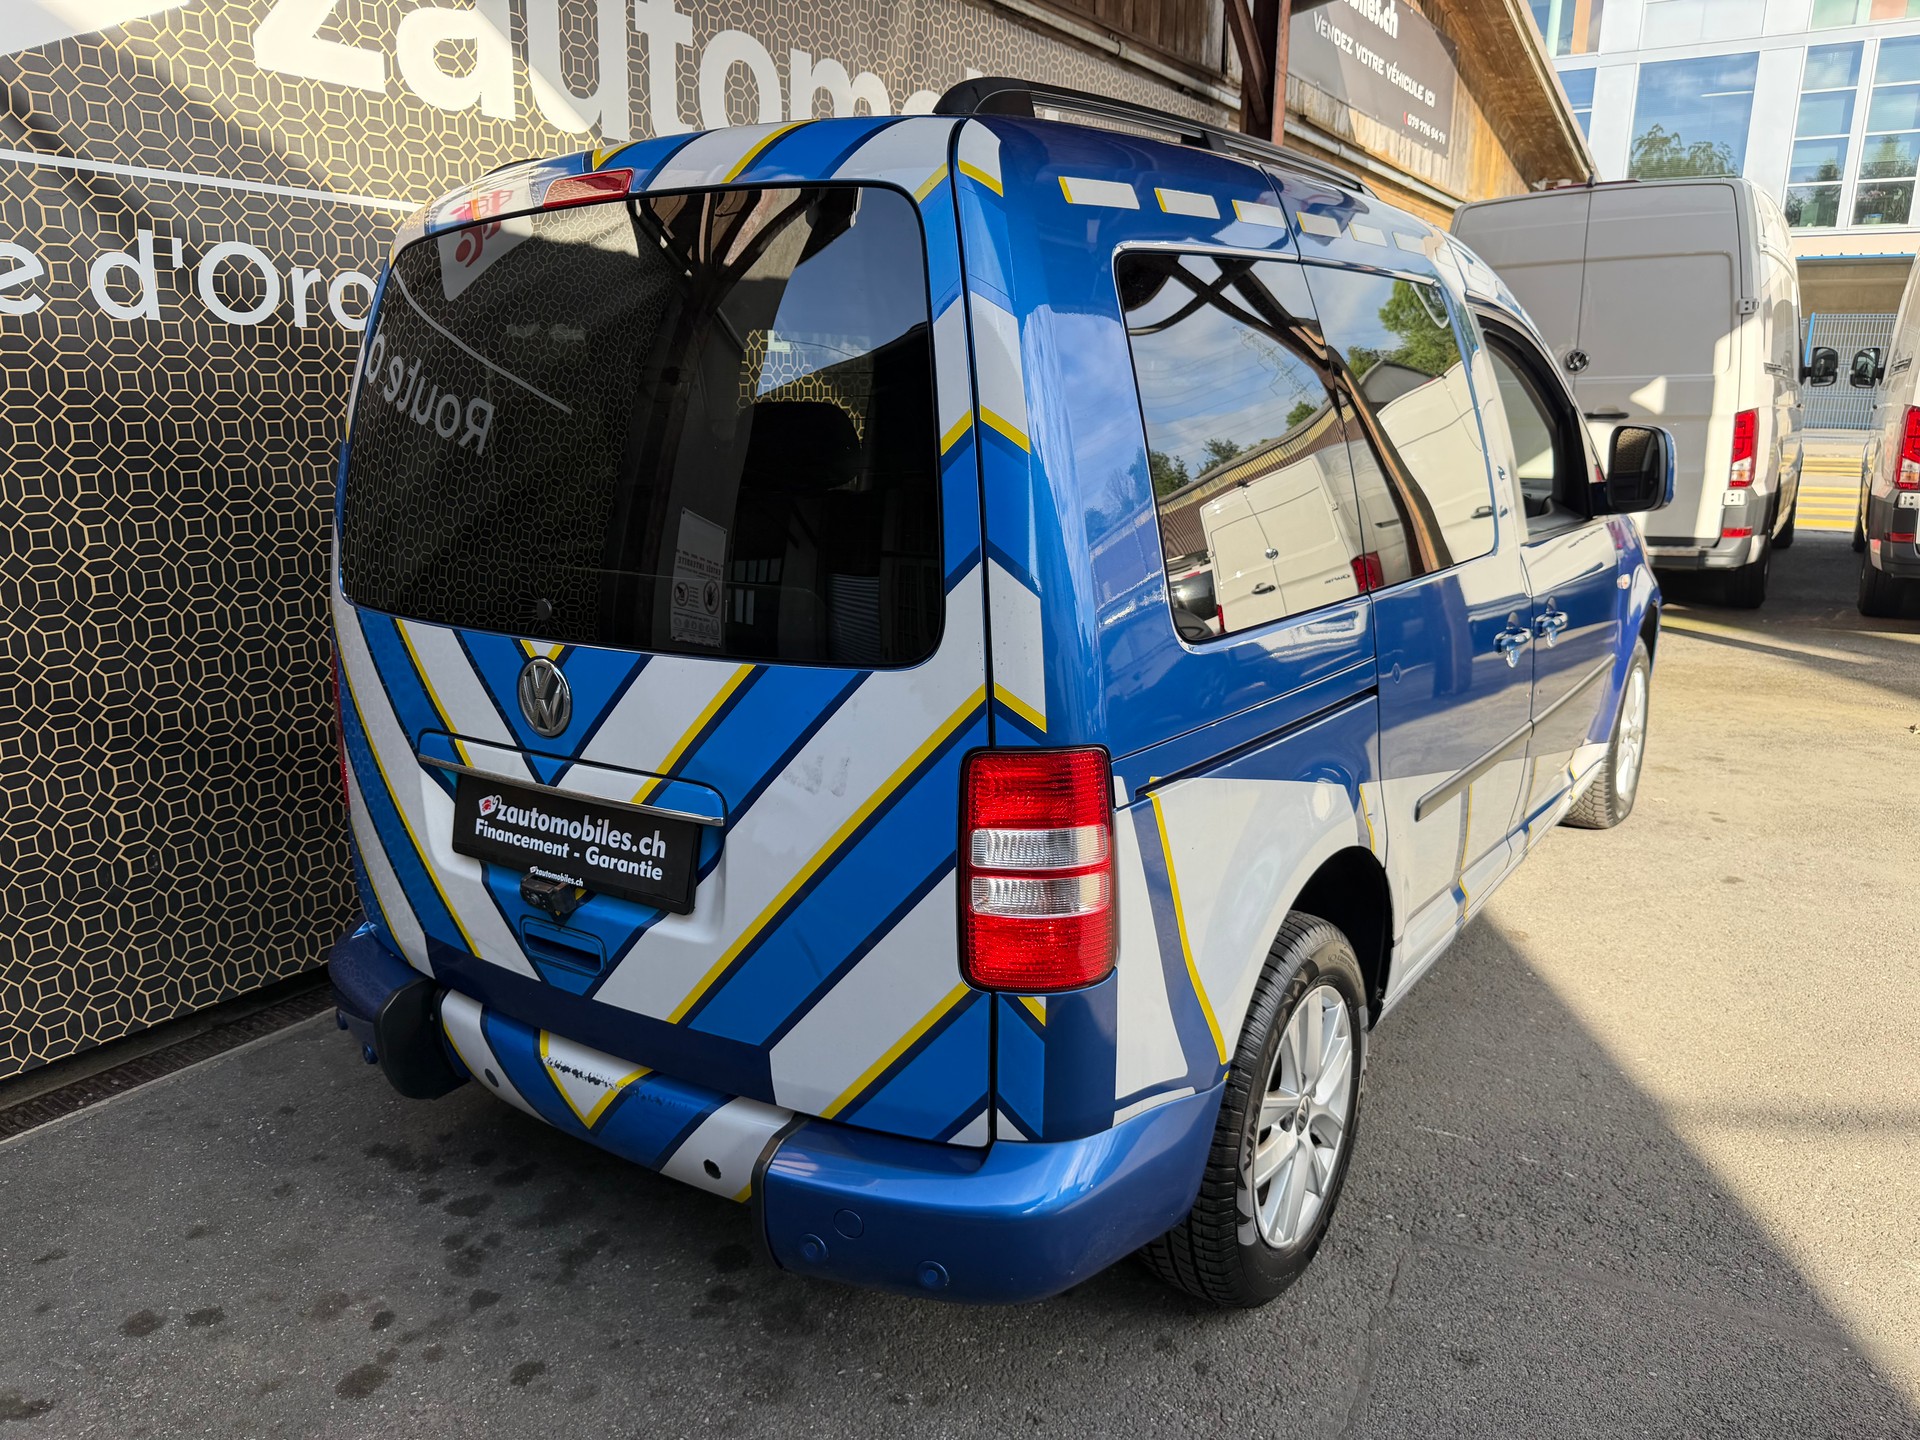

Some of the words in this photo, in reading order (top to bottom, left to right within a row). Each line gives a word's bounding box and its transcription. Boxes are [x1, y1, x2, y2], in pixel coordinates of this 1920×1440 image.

[1313, 11, 1353, 55] VENDEZ
[1356, 42, 1385, 75] VOTRE
[1386, 61, 1425, 100] VÉHICULE
[1424, 88, 1436, 107] ICI
[474, 818, 570, 859] Financement
[585, 847, 663, 881] Garantie
[496, 802, 666, 858] zautomobiles.ch
[535, 869, 584, 887] zautomobiles.ch
